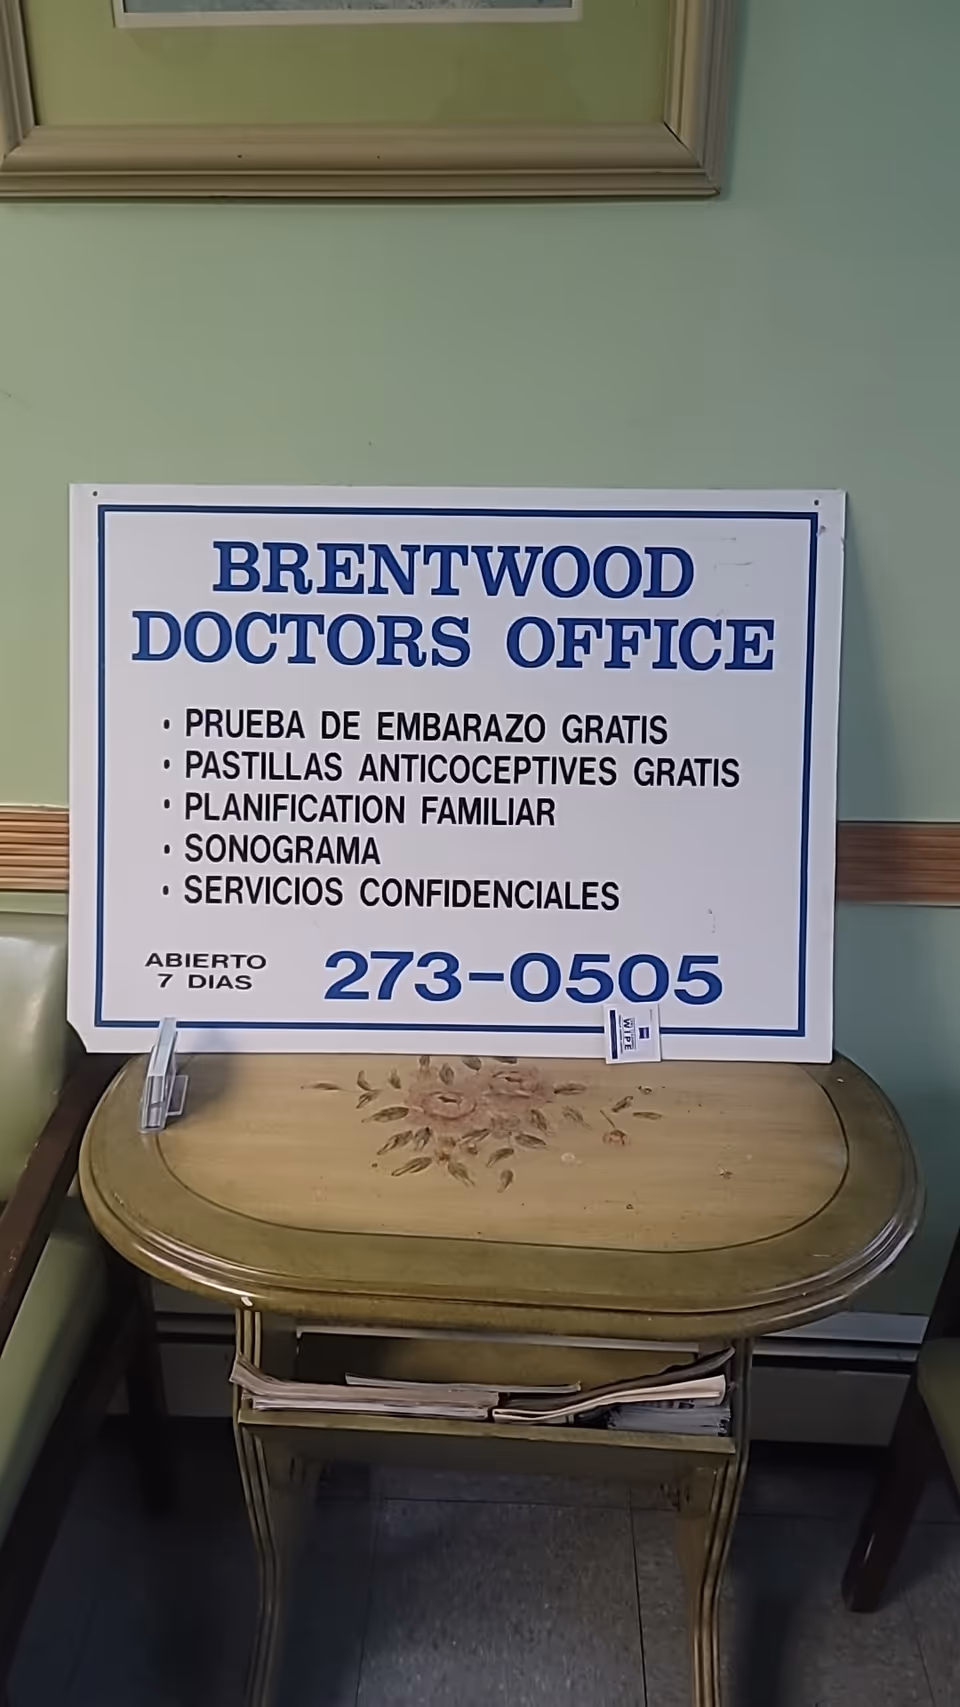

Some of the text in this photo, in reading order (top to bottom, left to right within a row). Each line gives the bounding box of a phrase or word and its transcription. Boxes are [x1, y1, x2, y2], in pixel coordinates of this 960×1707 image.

[212, 540, 695, 600] BRENTWOOD
[131, 610, 775, 672] DOCTORS OFFICE
[185, 708, 668, 745] PRUEBA DE EMBARAZO GRATIS
[185, 750, 740, 788] PASTILLAS ANTICOCEPTIVES GRATIS
[185, 791, 556, 826] PLANIFICATION FAMILIAR
[184, 832, 381, 865] SONOGRAMA
[184, 874, 620, 911] SERVICIOS CONFIDENCIALES
[144, 952, 267, 970] ABIERTO
[324, 950, 723, 1006] 273-0505
[157, 973, 253, 990] 7 DIAS
[622, 1018, 633, 1051] WIPE
